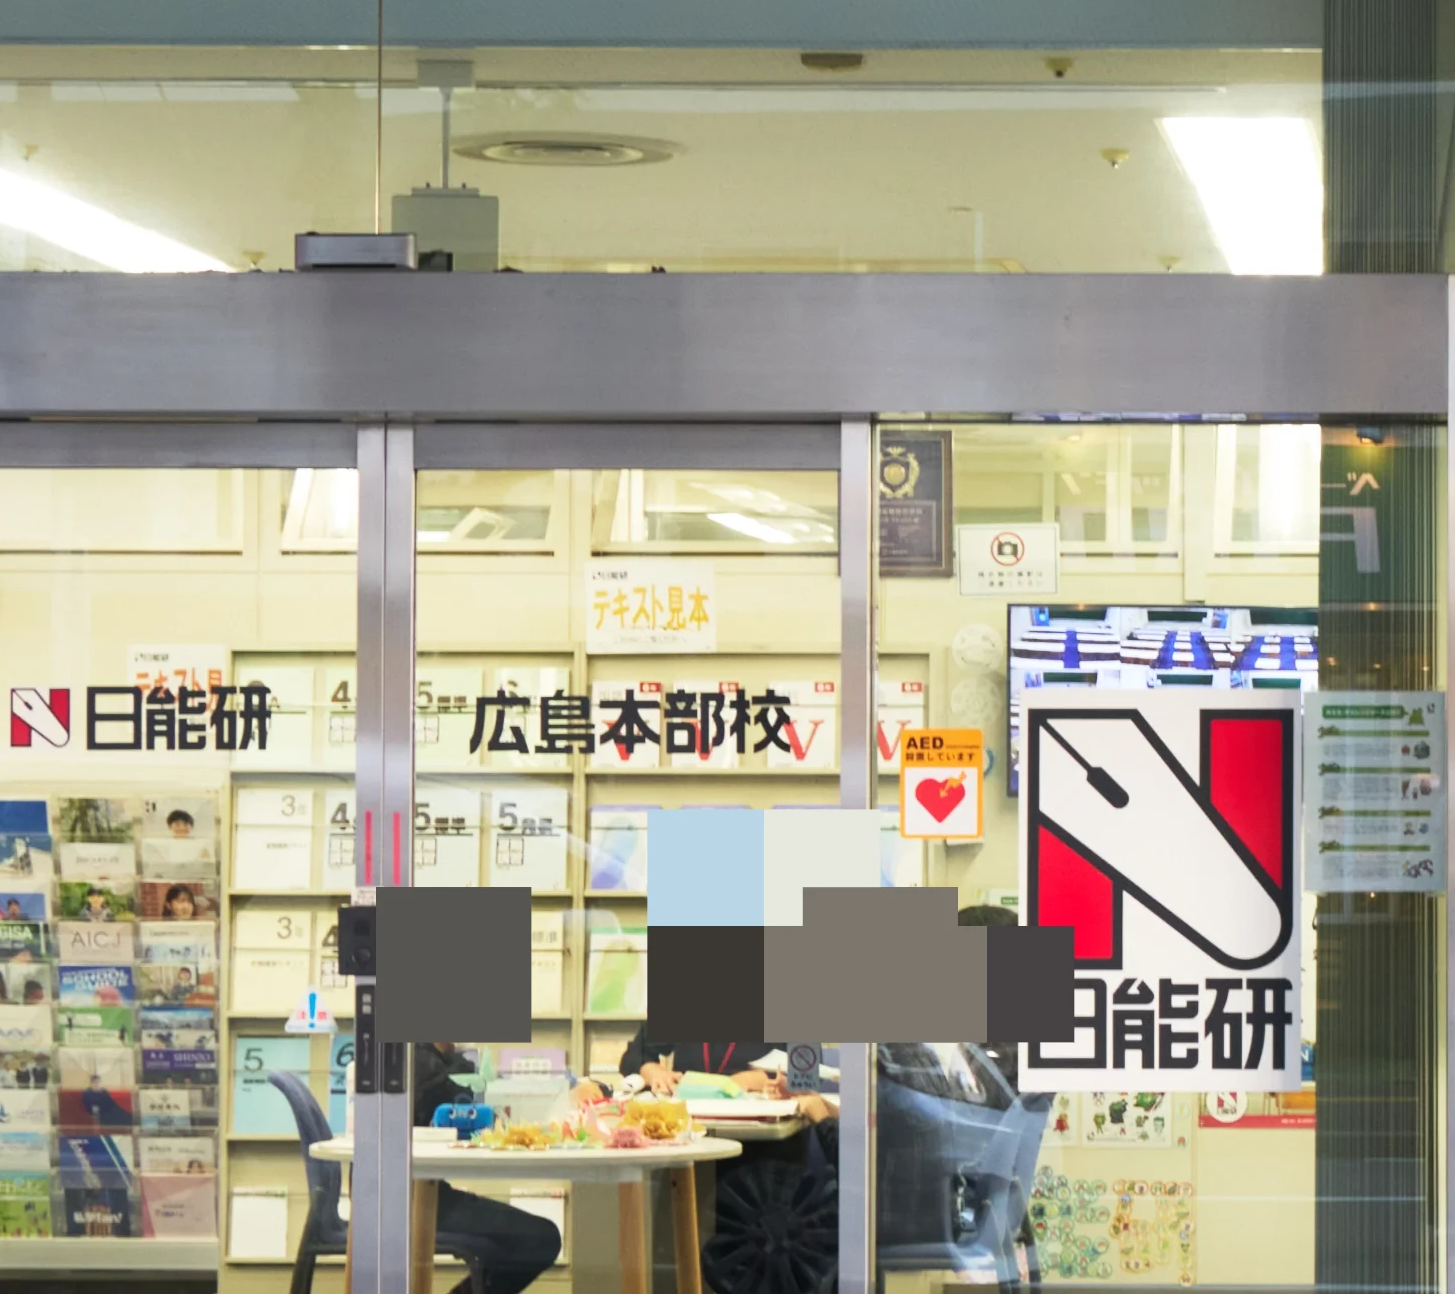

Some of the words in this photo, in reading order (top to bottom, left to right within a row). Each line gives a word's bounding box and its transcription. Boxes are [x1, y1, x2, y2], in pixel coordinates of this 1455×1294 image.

[593, 583, 709, 631] テキスト見本
[86, 685, 272, 751] 日能研
[469, 689, 792, 755] 広島本部校
[906, 736, 945, 750] AED
[70, 930, 122, 947] AICJ
[1027, 977, 1294, 1071] 日能研
